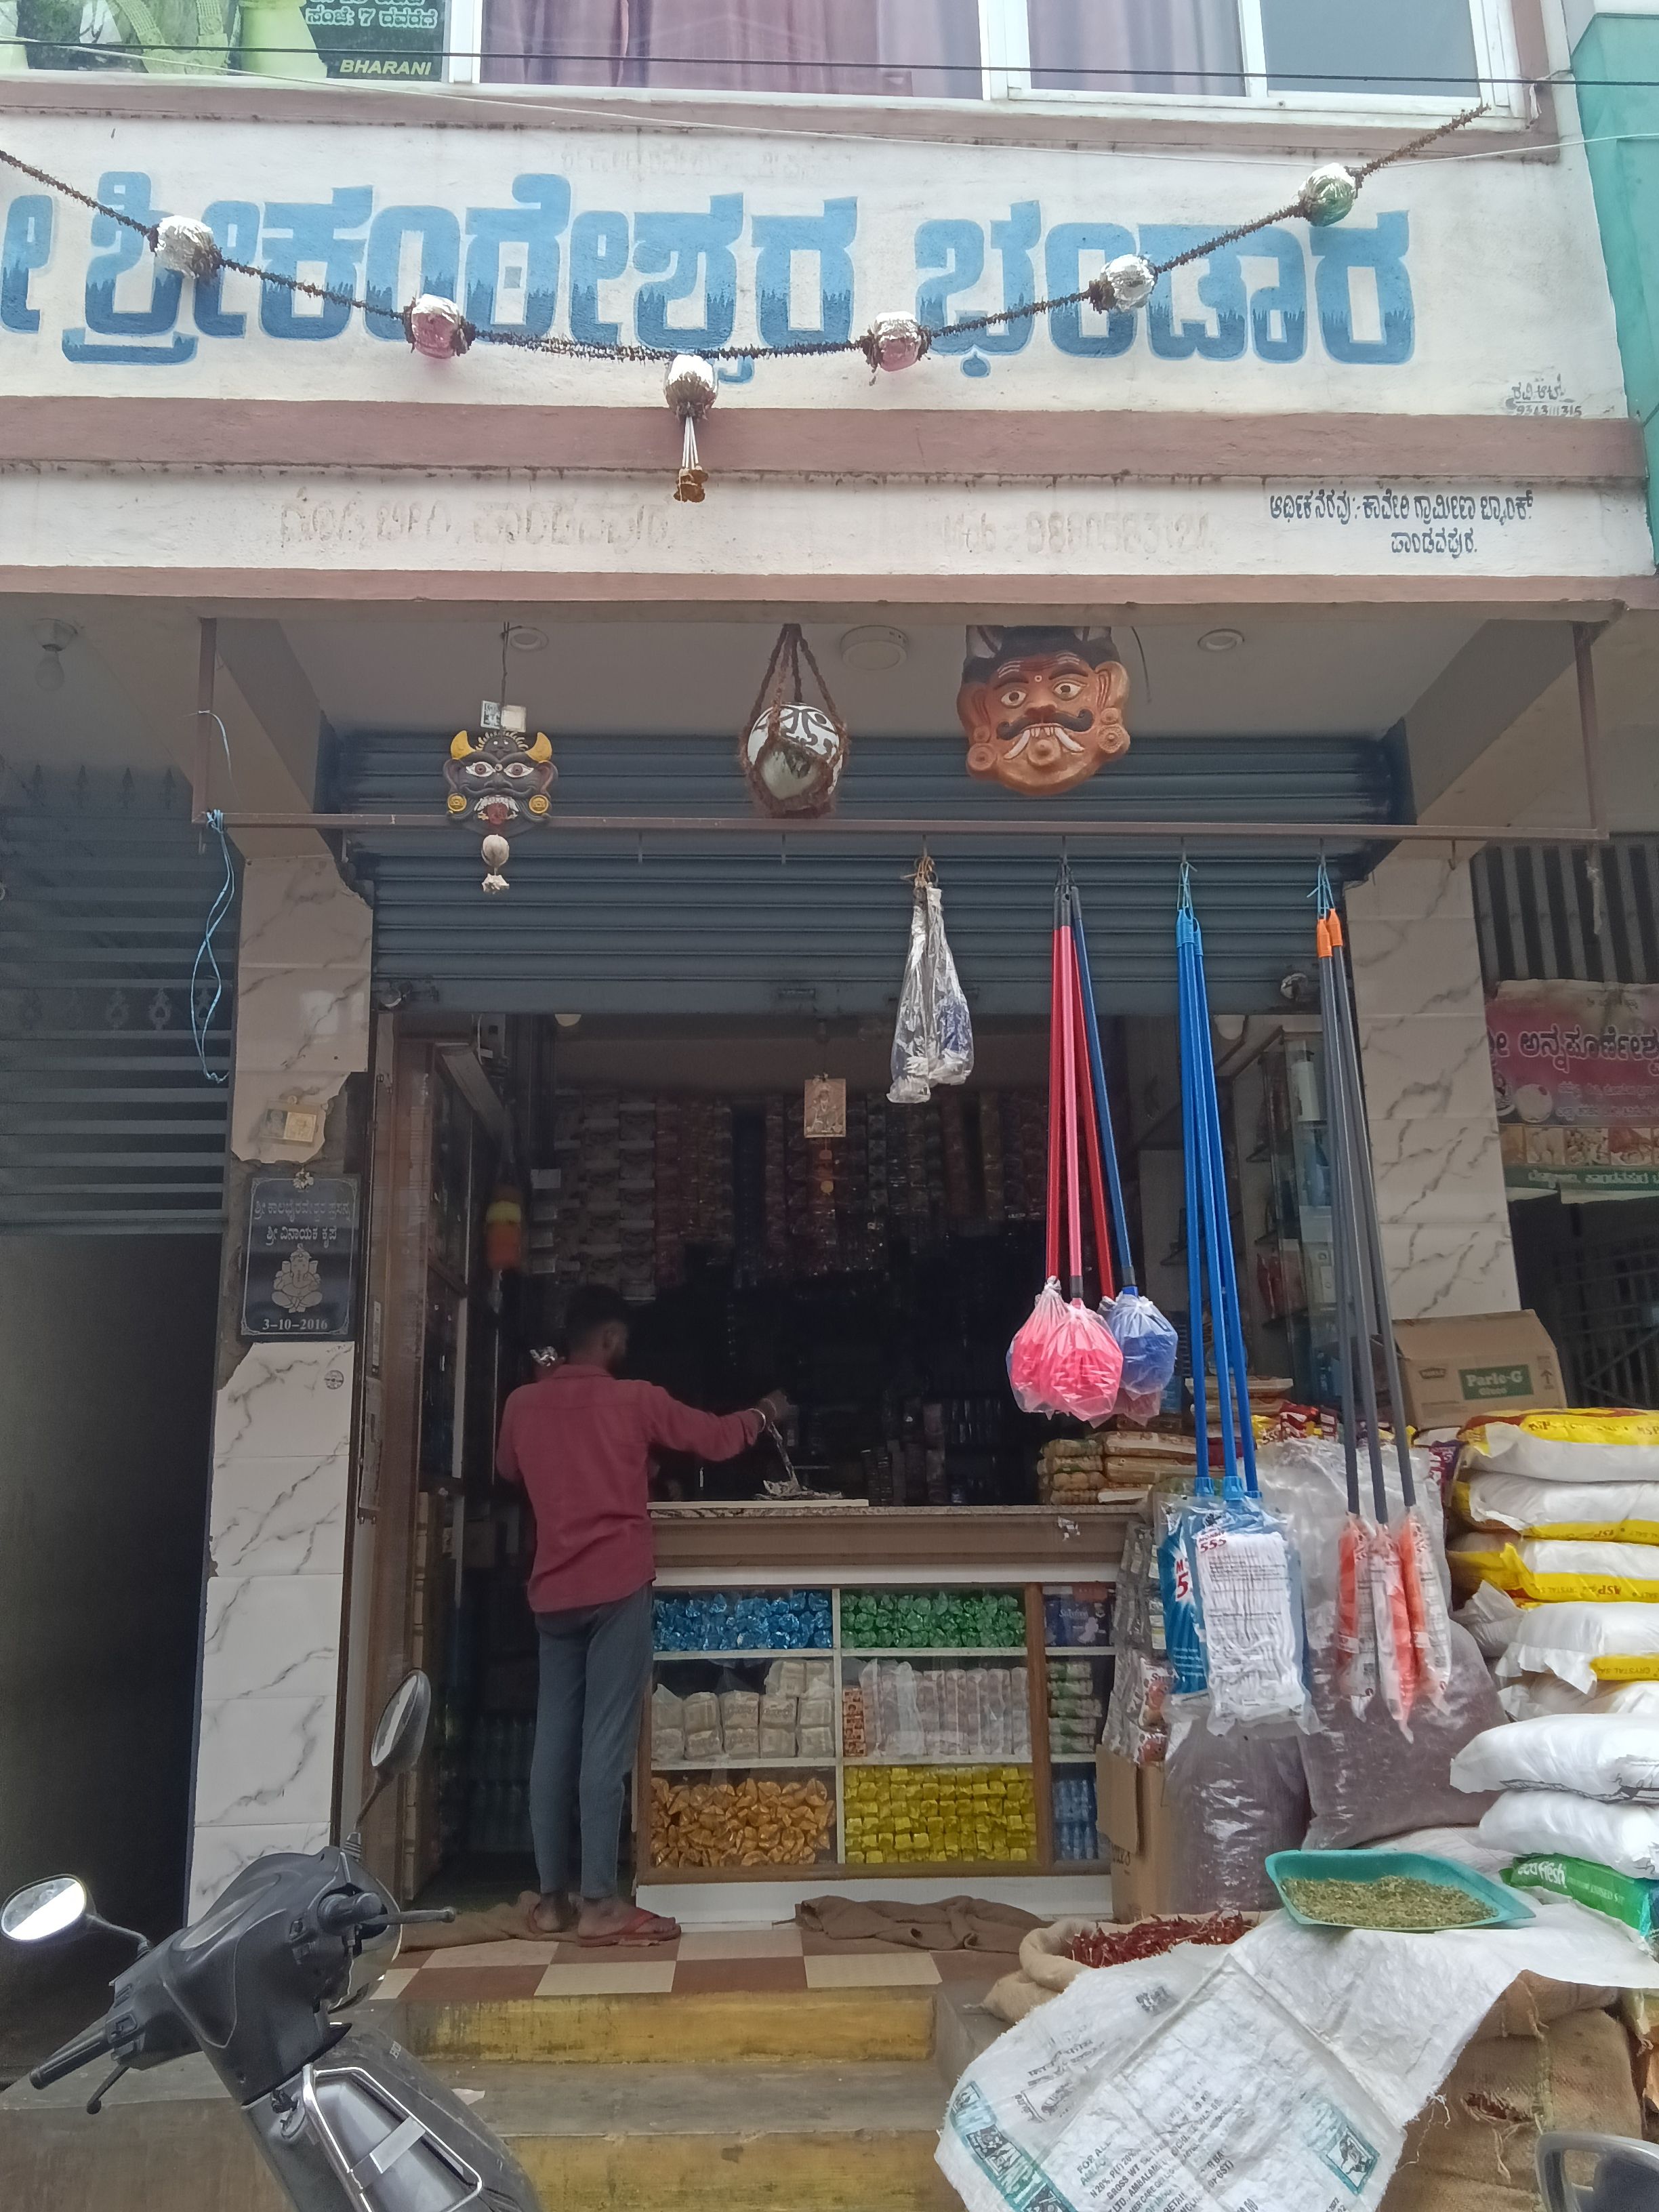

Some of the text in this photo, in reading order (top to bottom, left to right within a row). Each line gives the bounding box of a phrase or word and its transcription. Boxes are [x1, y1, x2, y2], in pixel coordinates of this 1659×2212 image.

[359, 8, 375, 26] 7
[340, 60, 432, 75] BHARANI
[916, 200, 1414, 377] ಭಂಡಾರ
[1415, 494, 1475, 525] ಗ್ರಾಮೀಣ
[266, 1226, 278, 1246] ಶ್ರೀ
[281, 1226, 319, 1240] ವಿನಾಯಕ
[262, 1319, 328, 1330] 3-10-2016
[1466, 1370, 1523, 1387] Parle-G
[1107, 2175, 1129, 2200] GROSS
